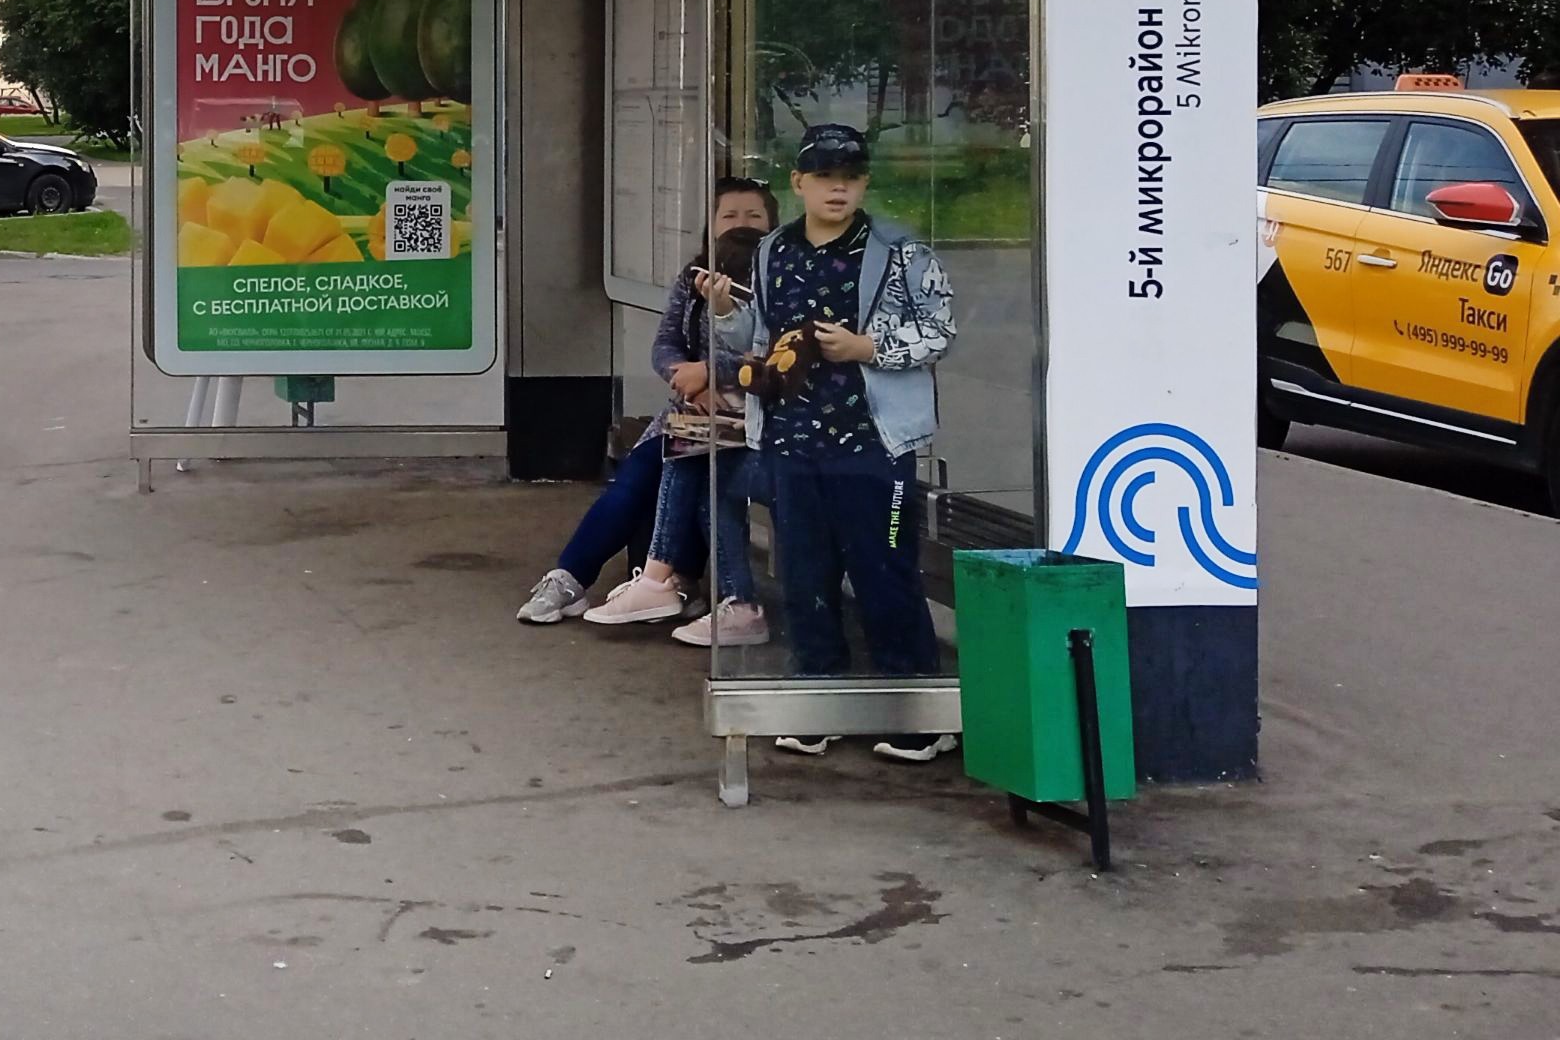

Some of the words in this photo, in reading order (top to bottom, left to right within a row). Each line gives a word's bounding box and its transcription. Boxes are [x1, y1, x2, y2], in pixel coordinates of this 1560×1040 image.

[195, 15, 293, 50] ГОДА
[195, 53, 317, 83] МАНГО
[1176, 93, 1201, 108] 5
[1128, 8, 1172, 235] микрорайон
[1128, 247, 1163, 299] 5-й
[1324, 247, 1352, 273] 567
[1417, 249, 1482, 283] Яндекс
[1486, 260, 1513, 289] Go
[233, 276, 311, 293] СПЕЛОЕ,
[315, 273, 408, 291] СЛАДКОЕ,
[192, 300, 207, 315] С
[211, 293, 333, 315] БЕСПЛАТНОЙ
[336, 290, 450, 314] ДОСТАВКОЙ
[1458, 297, 1508, 333] Такси
[1406, 322, 1438, 347] (495)
[1441, 332, 1509, 364] 999-99-99
[891, 480, 904, 510] FUTURE
[890, 510, 900, 526] THE
[888, 526, 899, 548] MAKE
